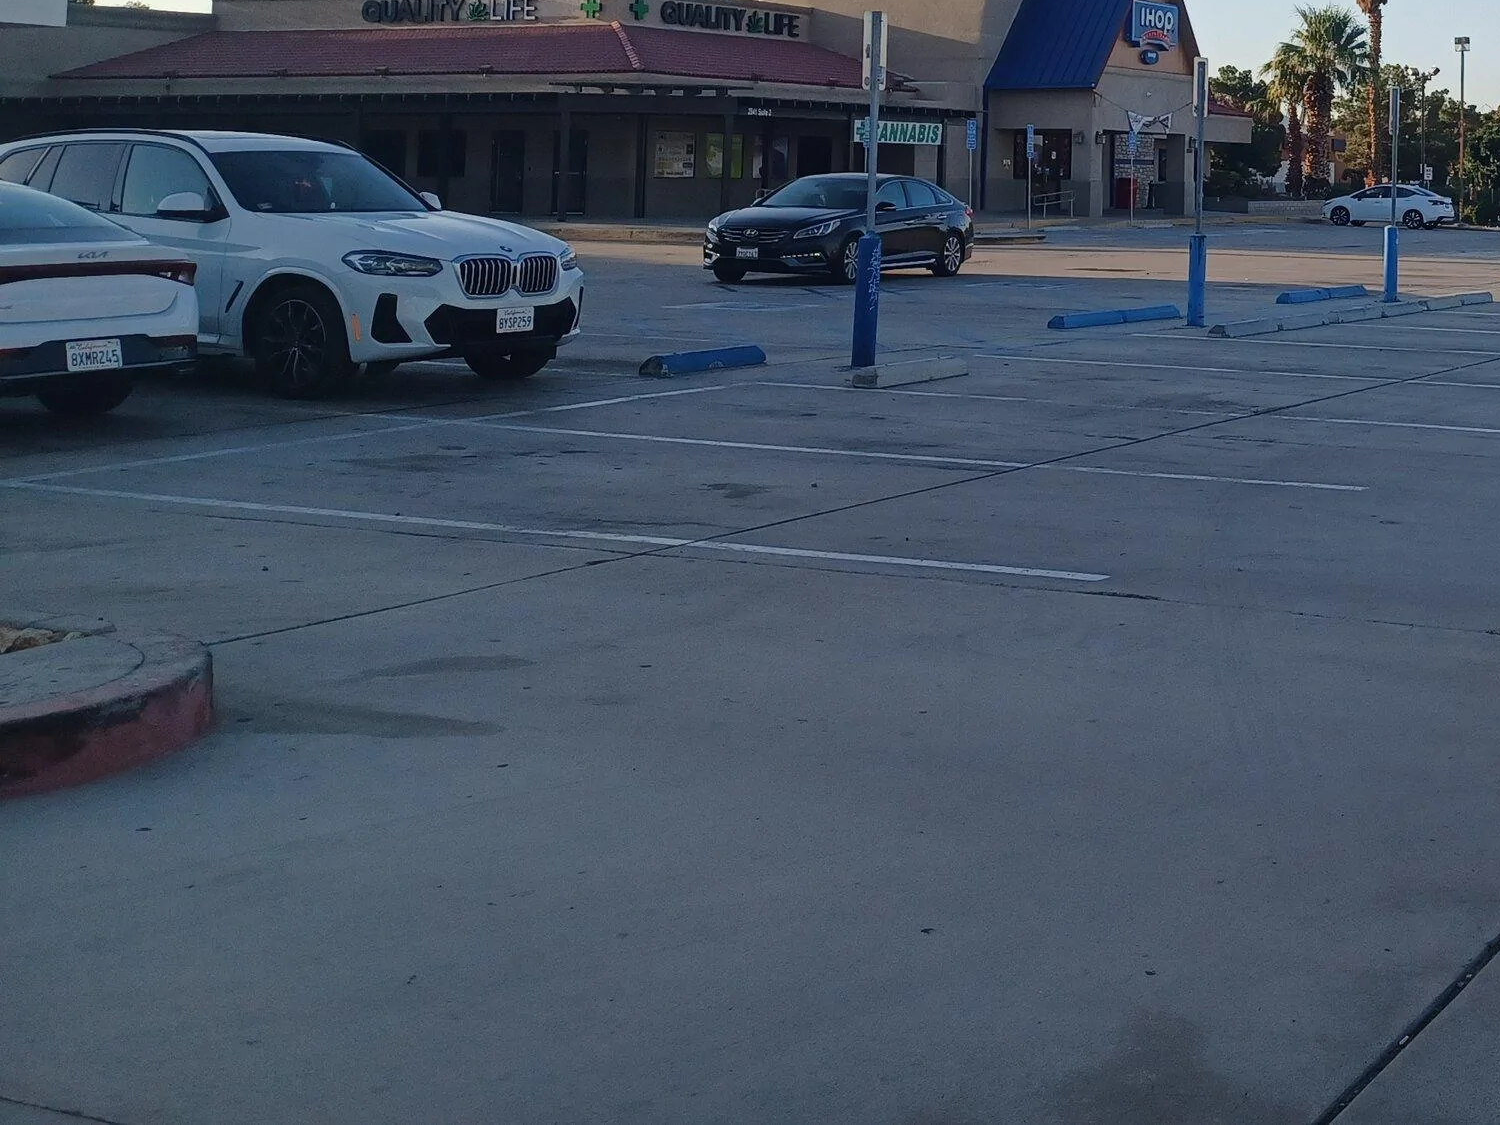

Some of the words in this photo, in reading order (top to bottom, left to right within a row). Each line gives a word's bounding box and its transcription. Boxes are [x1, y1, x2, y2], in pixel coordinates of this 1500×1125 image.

[660, 1, 747, 32] QUALITY
[764, 12, 800, 38] LIFE
[1141, 7, 1174, 35] IHOP
[876, 122, 939, 144] ANNABIS
[499, 316, 532, 329] 8YSP259
[71, 349, 119, 367] 8XMR245
